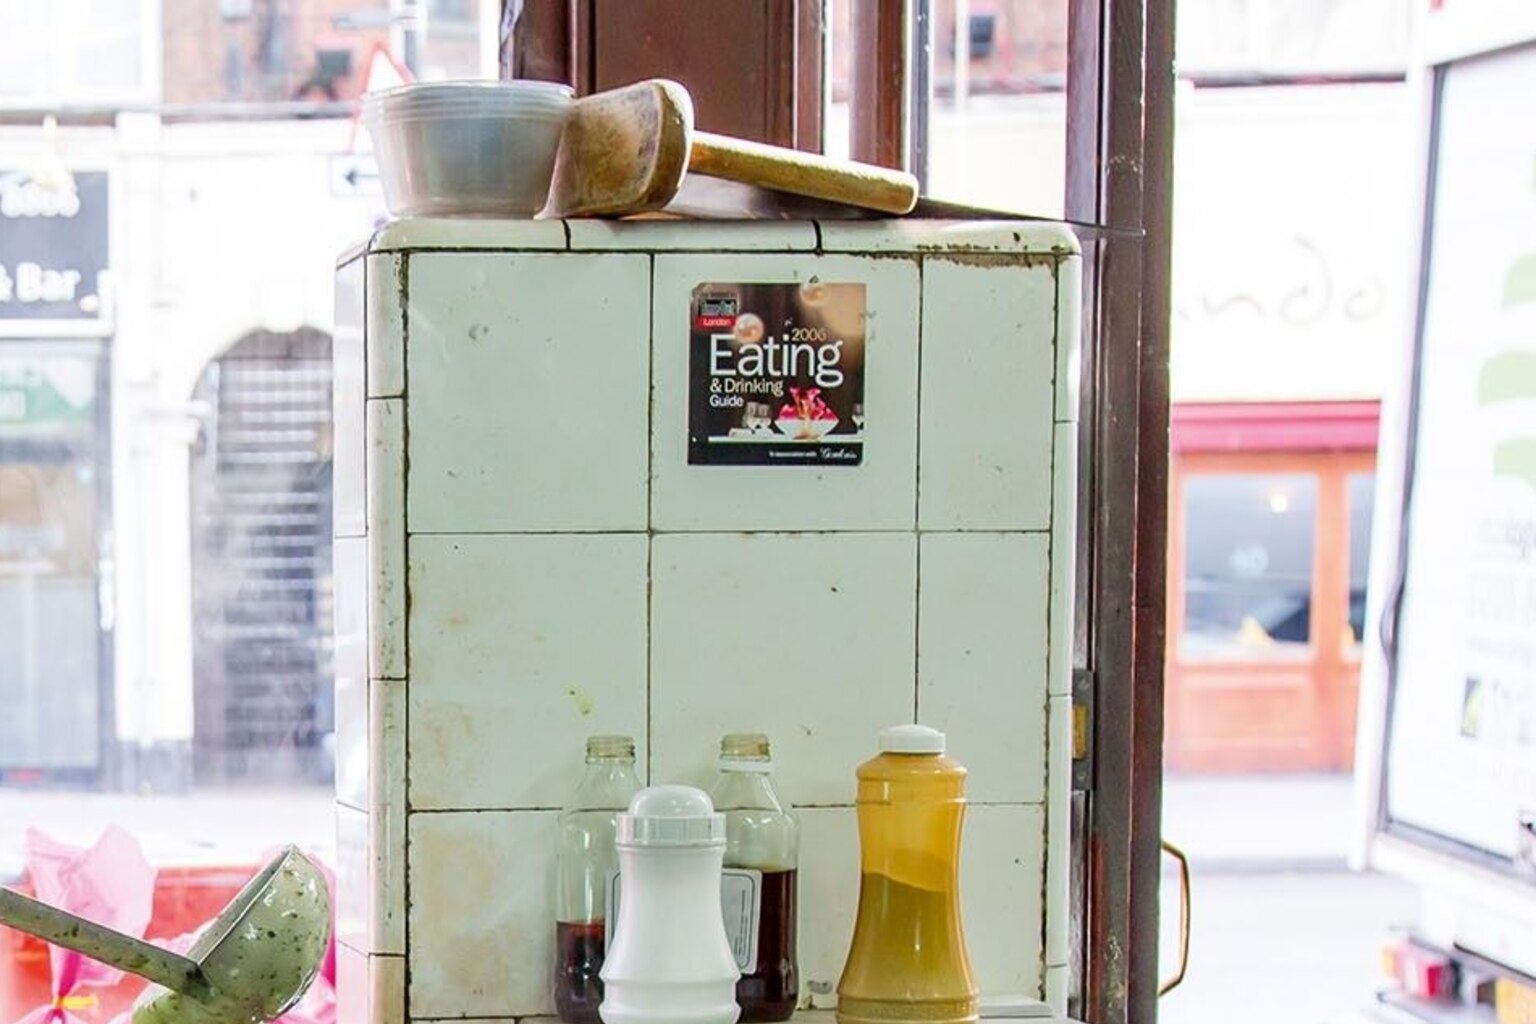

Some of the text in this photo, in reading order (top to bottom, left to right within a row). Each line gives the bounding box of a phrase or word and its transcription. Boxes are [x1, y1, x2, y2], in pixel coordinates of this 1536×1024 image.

[16, 262, 82, 303] Bar
[703, 316, 731, 327] London
[710, 333, 844, 388] Eating
[709, 378, 784, 397] & Drinking
[709, 394, 744, 408] Guide
